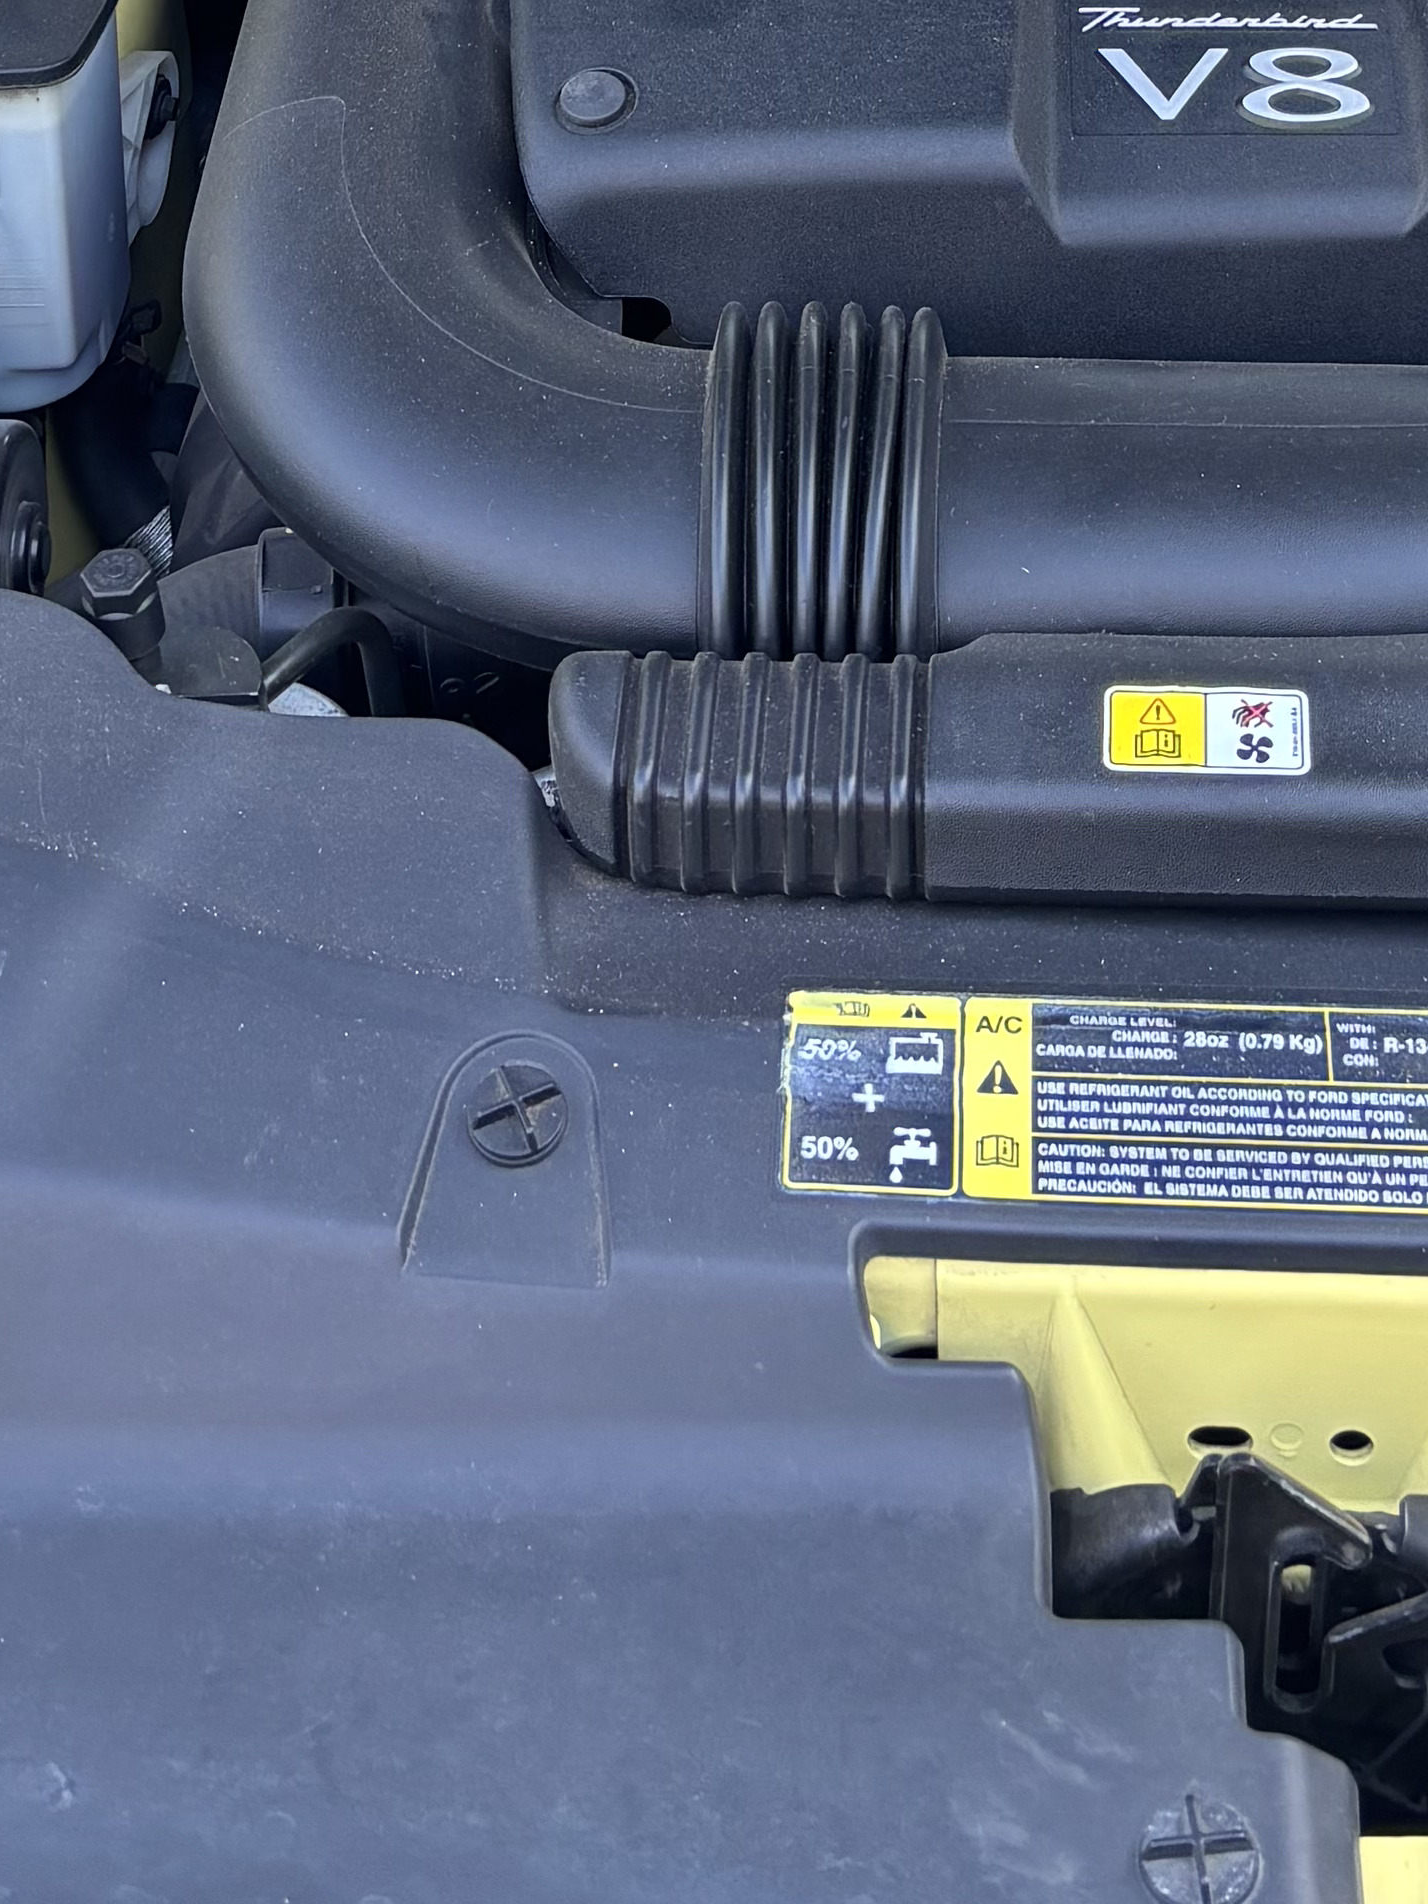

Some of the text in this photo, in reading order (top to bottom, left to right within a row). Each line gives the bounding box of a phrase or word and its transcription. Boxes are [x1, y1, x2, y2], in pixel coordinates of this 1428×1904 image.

[1077, 5, 1379, 33] Thunderbird
[1096, 46, 1372, 123] V8
[976, 1015, 1023, 1033] A/C
[1069, 1015, 1176, 1028] CHARGE LEVEL:
[1336, 1023, 1375, 1034] WITH:
[1111, 1030, 1169, 1043] CHARGE
[1182, 1030, 1323, 1054] 28oz (0.79 Kg)
[1349, 1037, 1368, 1049] DE
[797, 1038, 860, 1061] 50%
[1036, 1043, 1177, 1060] CARGA DE LLENADO:
[1342, 1054, 1378, 1066] CON:
[1036, 1081, 1065, 1094] USE
[1069, 1082, 1168, 1097] REFRIGERANT
[1171, 1086, 1194, 1098] OIL
[1197, 1086, 1282, 1101] ACCORDING
[1286, 1089, 1304, 1102] TO
[1308, 1090, 1347, 1103] FORD
[1037, 1098, 1100, 1113] UTILISER
[1103, 1100, 1186, 1115] LUBRIFIANT
[1189, 1103, 1270, 1118] CONFORME
[1287, 1107, 1305, 1119] LA
[1309, 1107, 1361, 1121] NORME
[1364, 1109, 1405, 1123] FORD
[1037, 1116, 1065, 1128] USE
[1068, 1117, 1118, 1130] ACEITE
[1123, 1118, 1161, 1131] PARA
[1164, 1120, 1283, 1135] REFRIGERANTES
[1286, 1124, 1367, 1138] CONFORME
[1370, 1126, 1381, 1139] A
[800, 1135, 859, 1160] 50%
[1038, 1142, 1105, 1158] CAUTION:
[1109, 1145, 1167, 1160] SYSTEM
[1170, 1147, 1189, 1160] TO
[1193, 1148, 1212, 1161] BE
[1216, 1149, 1287, 1164] SERVICED
[1290, 1151, 1310, 1165] BY
[1314, 1153, 1390, 1167] QUALIFIED
[1038, 1160, 1072, 1174] MISE
[1076, 1161, 1095, 1175] EN
[1099, 1163, 1149, 1177] GARDE
[1161, 1165, 1180, 1178] NE
[1185, 1165, 1247, 1180] CONFIER
[1251, 1168, 1342, 1183] L'ENTRETIEN
[1385, 1172, 1405, 1185] UN
[1144, 1181, 1162, 1195] EL
[1166, 1182, 1228, 1197] SISTEMA
[1231, 1185, 1271, 1198] DEBE
[1274, 1186, 1303, 1199] SER
[1306, 1187, 1379, 1202] ATENDIDO
[1382, 1190, 1422, 1203] SOLO
